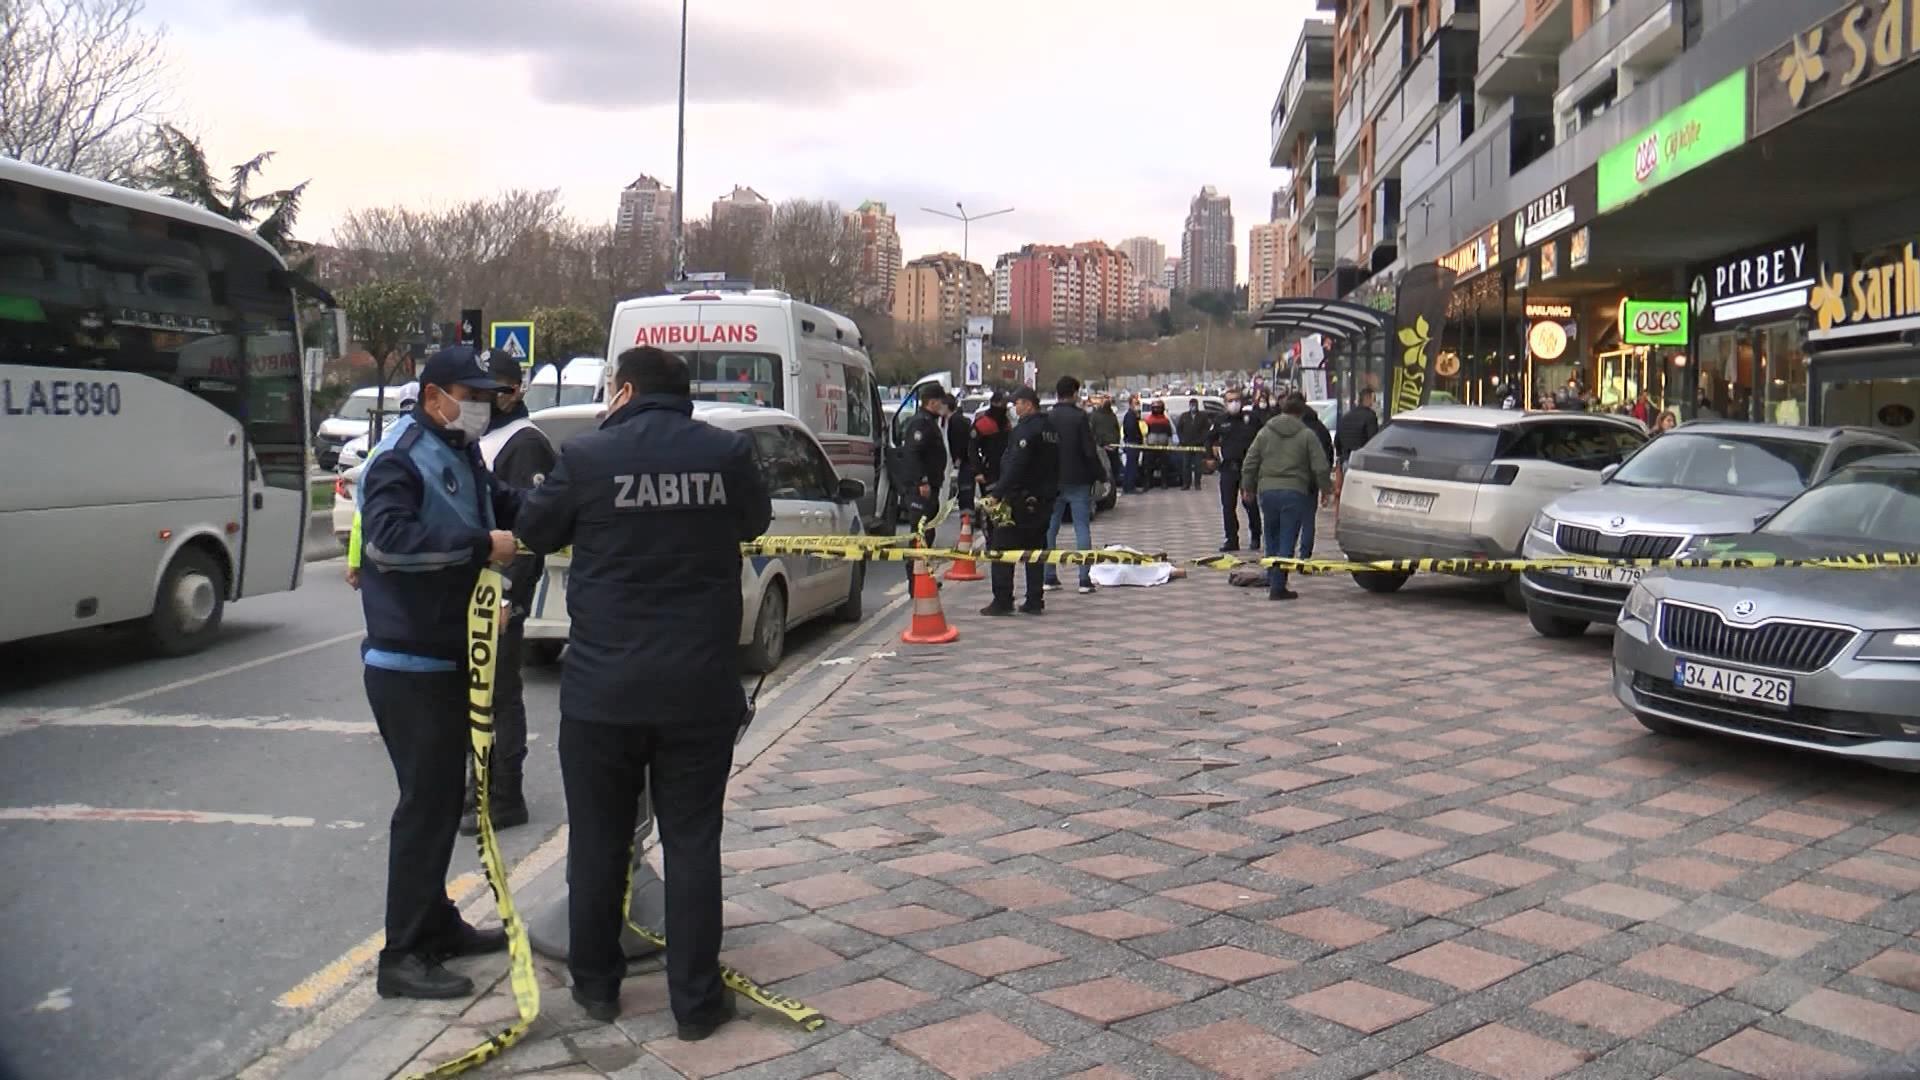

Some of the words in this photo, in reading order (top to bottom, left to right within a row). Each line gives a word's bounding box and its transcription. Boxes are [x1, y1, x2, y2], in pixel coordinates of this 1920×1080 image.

[635, 323, 759, 345] AMBULANS
[3, 379, 121, 416] LAE890
[613, 472, 728, 508] ZABITA
[1686, 665, 1706, 687] 34
[1712, 670, 1745, 694] AIC
[1752, 677, 1788, 702] 226
